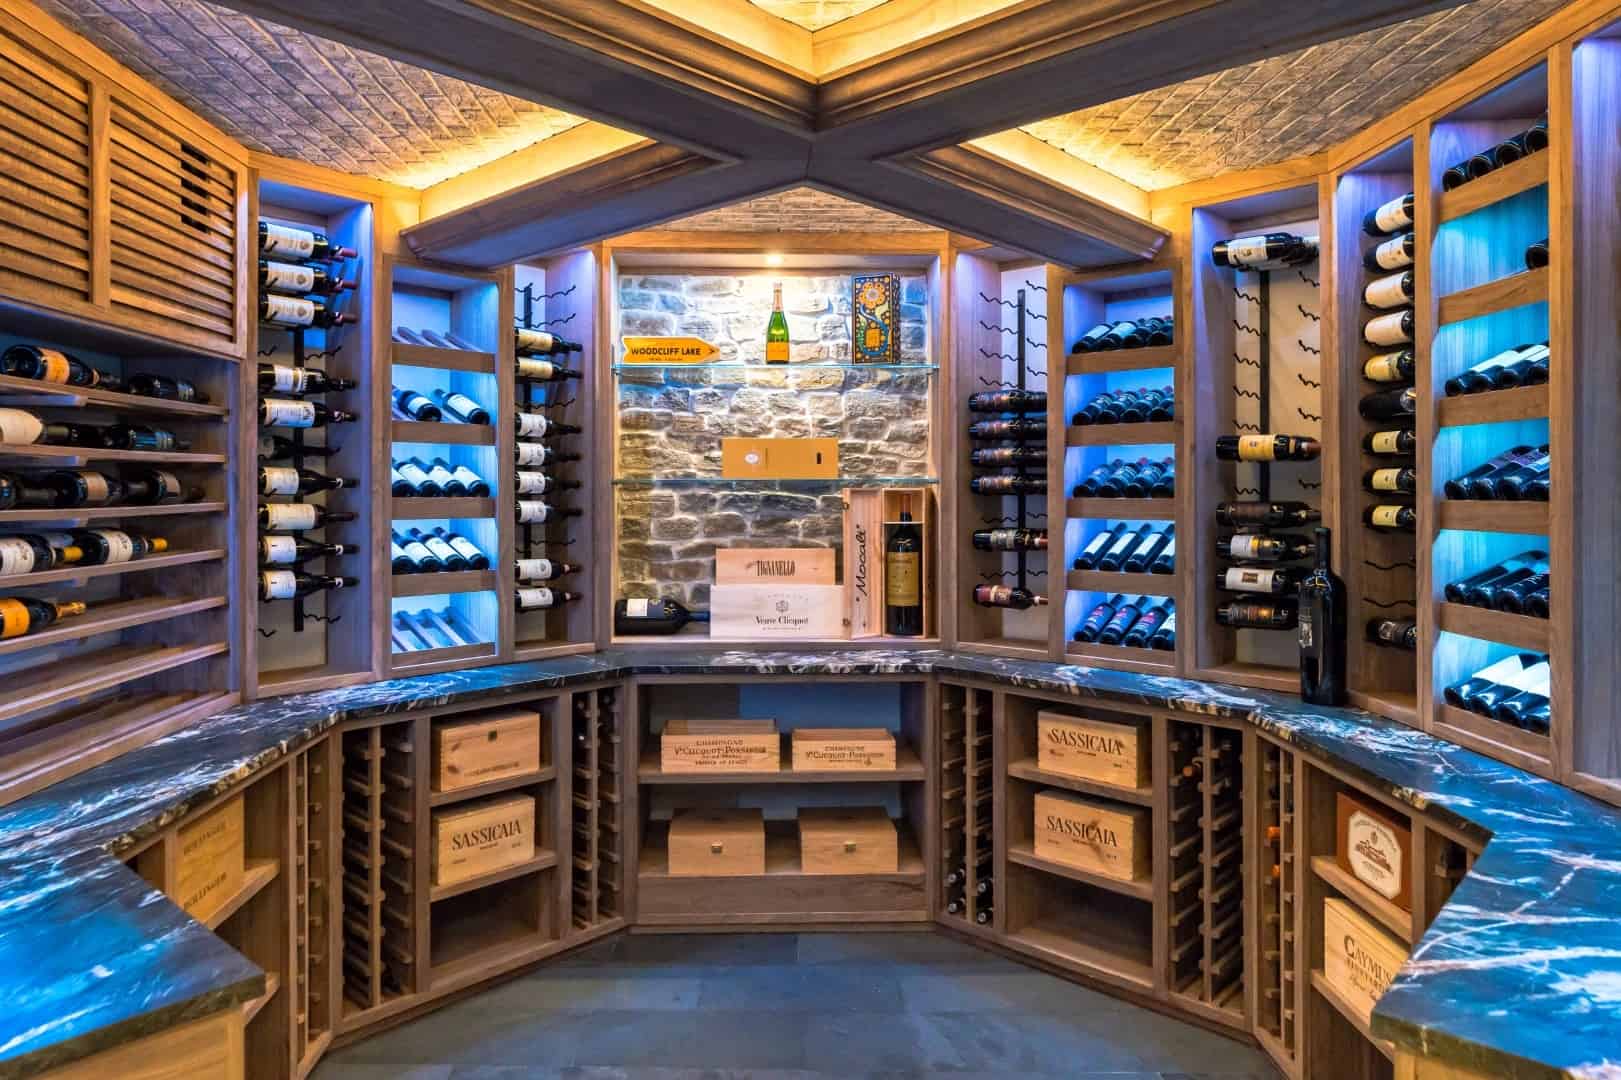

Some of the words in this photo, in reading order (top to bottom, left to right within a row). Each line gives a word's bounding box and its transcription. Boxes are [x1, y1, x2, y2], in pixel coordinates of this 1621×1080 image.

[631, 347, 680, 356] WOODCLIFF
[682, 347, 701, 356] LAKE
[756, 560, 796, 577] TIGNANELLO
[755, 615, 776, 625] Veuve
[778, 615, 808, 627] Clicquot
[1049, 728, 1122, 756] SASSICAIA
[451, 819, 522, 851] SASSICAIA
[1046, 815, 1118, 848] SASSICAIA
